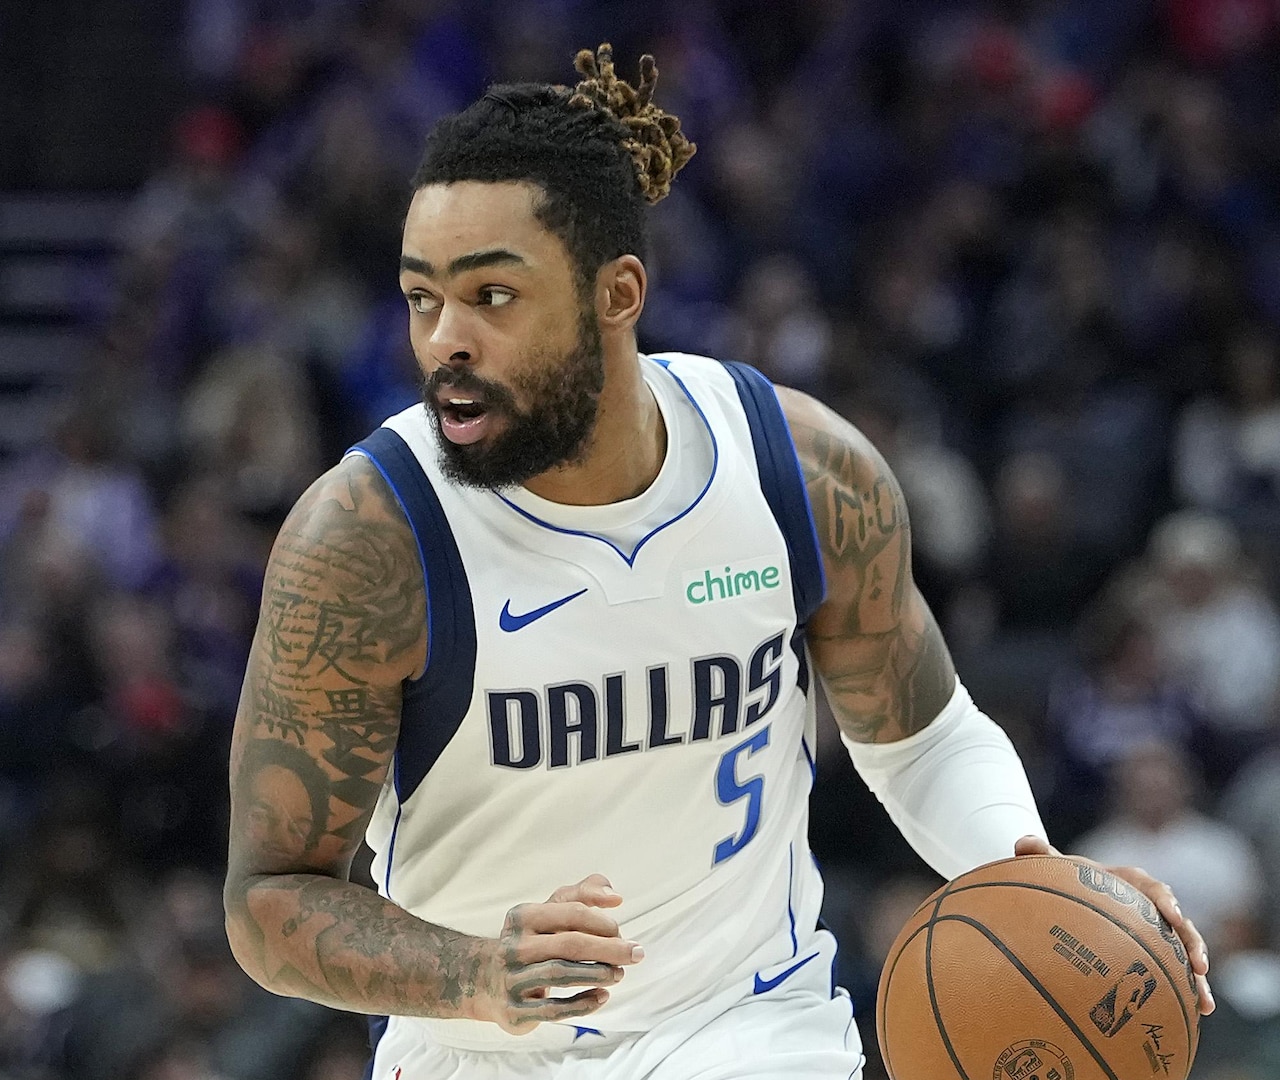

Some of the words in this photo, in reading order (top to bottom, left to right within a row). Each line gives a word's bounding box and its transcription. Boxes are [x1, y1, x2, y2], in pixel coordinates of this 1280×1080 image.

[686, 563, 780, 606] chime
[484, 628, 787, 772] DALLAS
[711, 723, 772, 869] 5
[1049, 925, 1080, 951] OFFICIAL
[1093, 958, 1111, 979] BALL
